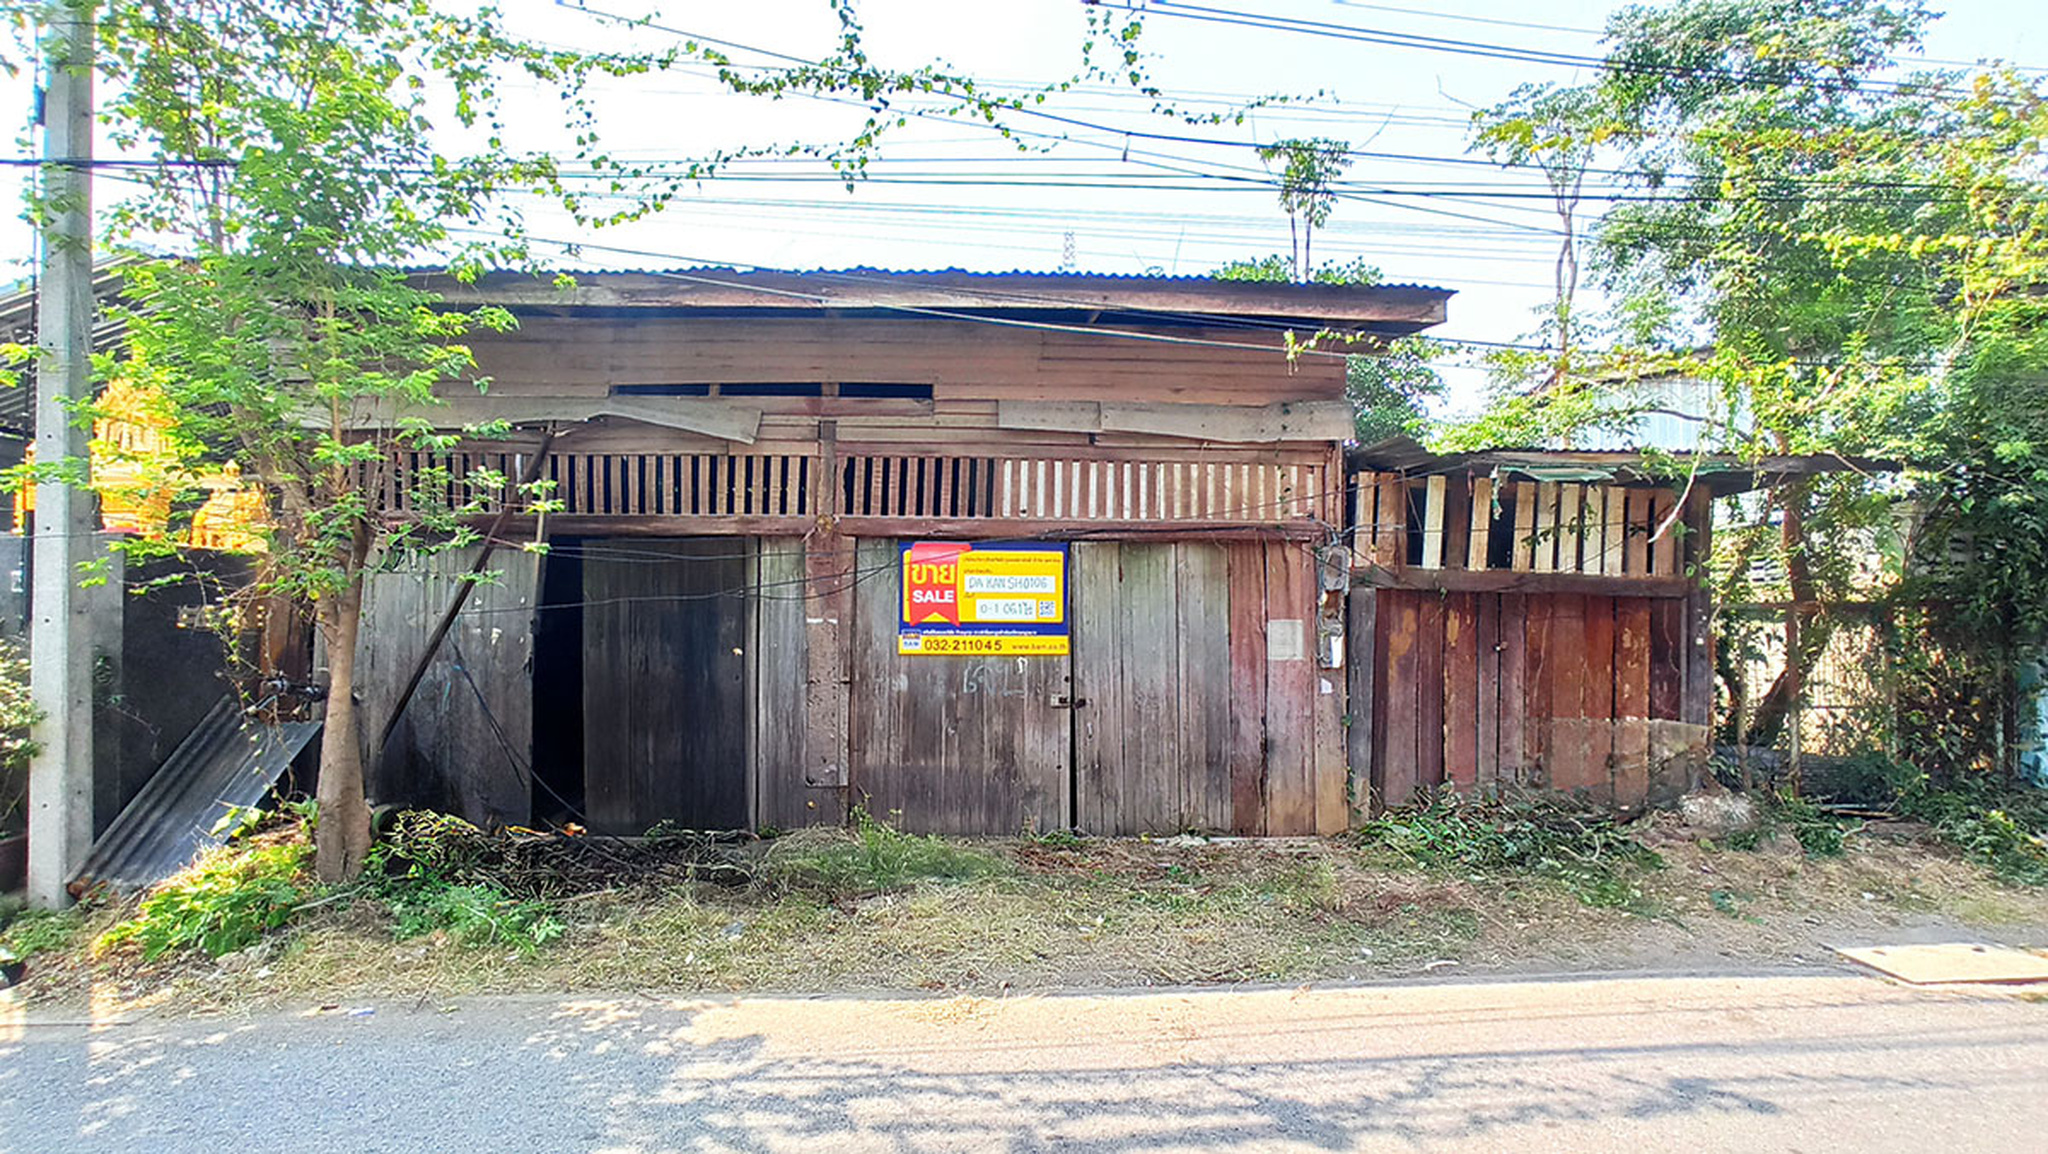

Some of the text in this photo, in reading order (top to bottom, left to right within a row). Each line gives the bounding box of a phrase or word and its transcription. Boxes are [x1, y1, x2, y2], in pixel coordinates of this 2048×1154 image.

[911, 563, 956, 585] ขาย
[912, 590, 955, 603] SALE
[924, 638, 1002, 651] 032-211045
